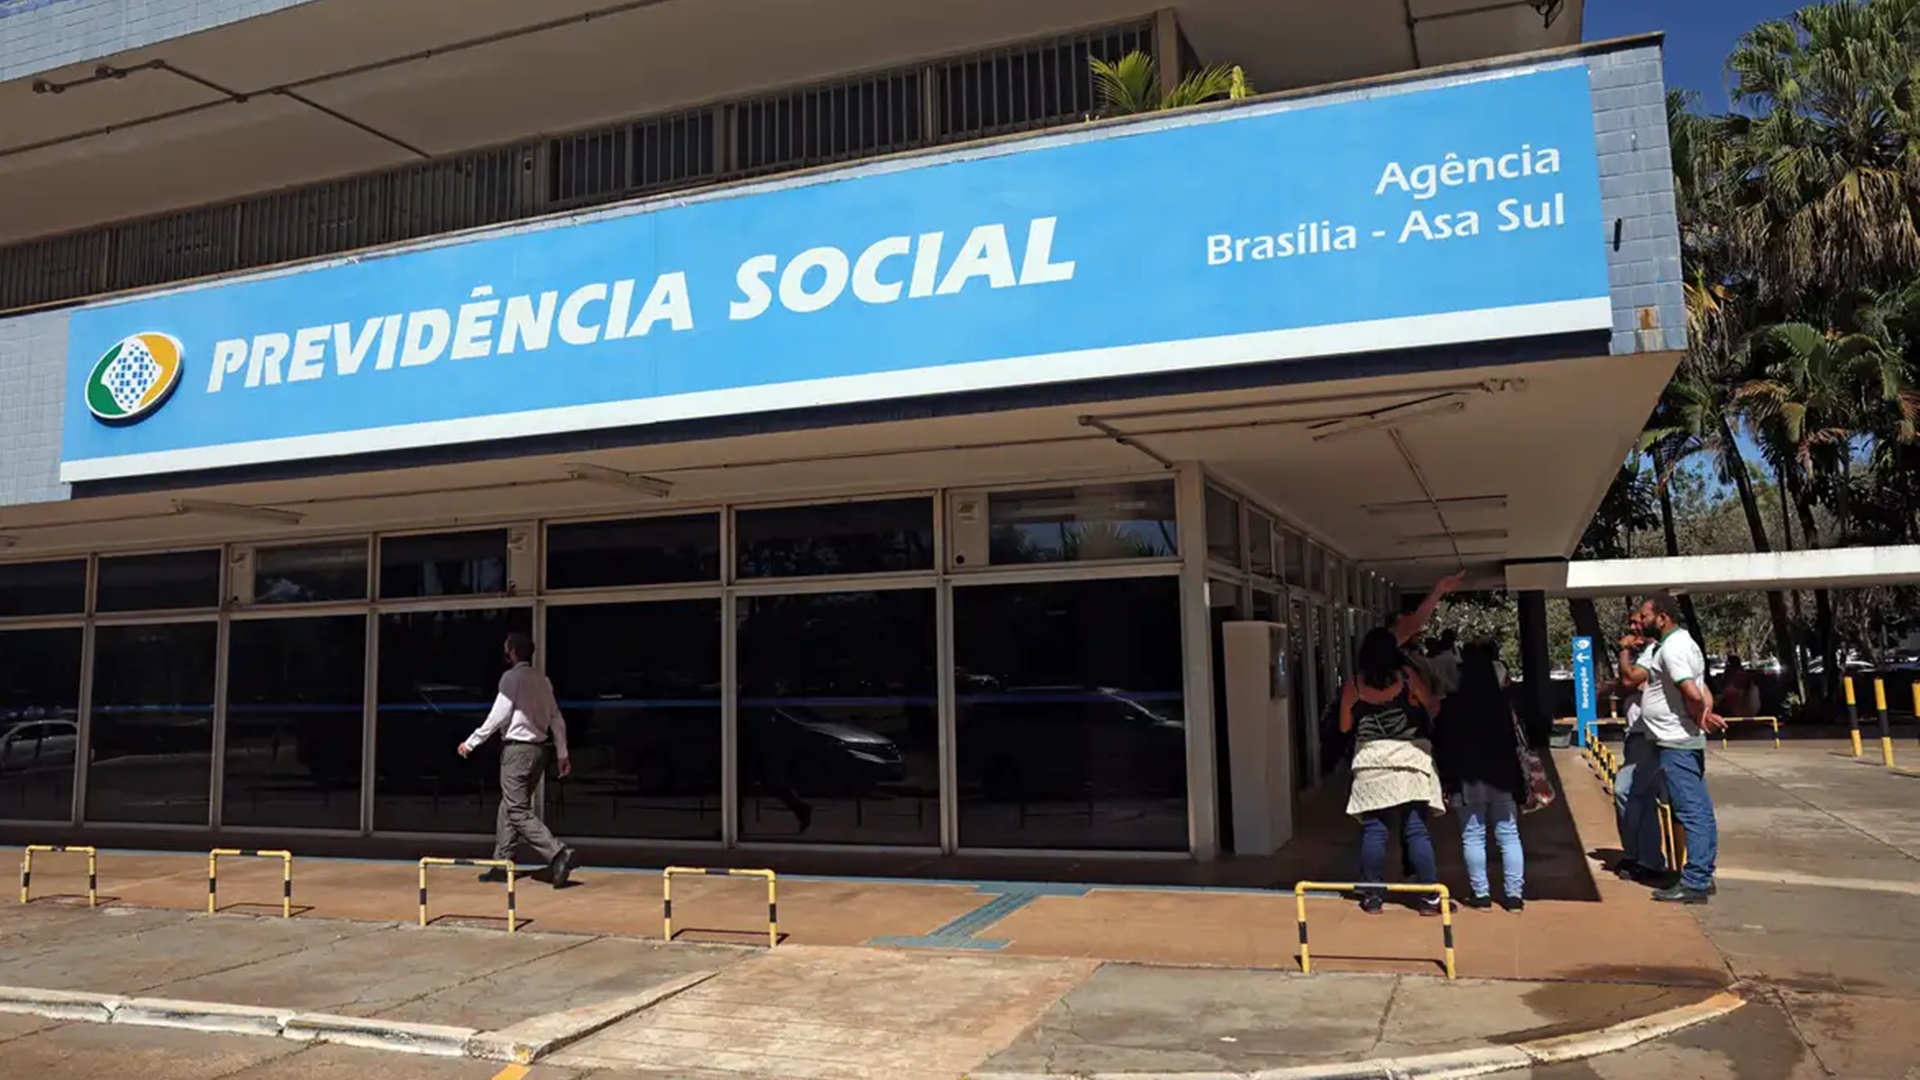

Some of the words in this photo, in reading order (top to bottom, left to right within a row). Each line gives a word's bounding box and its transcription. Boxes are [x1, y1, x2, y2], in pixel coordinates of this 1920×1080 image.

[1375, 144, 1561, 200] Agência
[1207, 220, 1357, 265] Brasília
[1399, 210, 1480, 243] Asa
[1497, 193, 1565, 231] Sul
[207, 271, 693, 393] PREVIDÊNCIA
[730, 216, 1076, 320] SOCIAL
